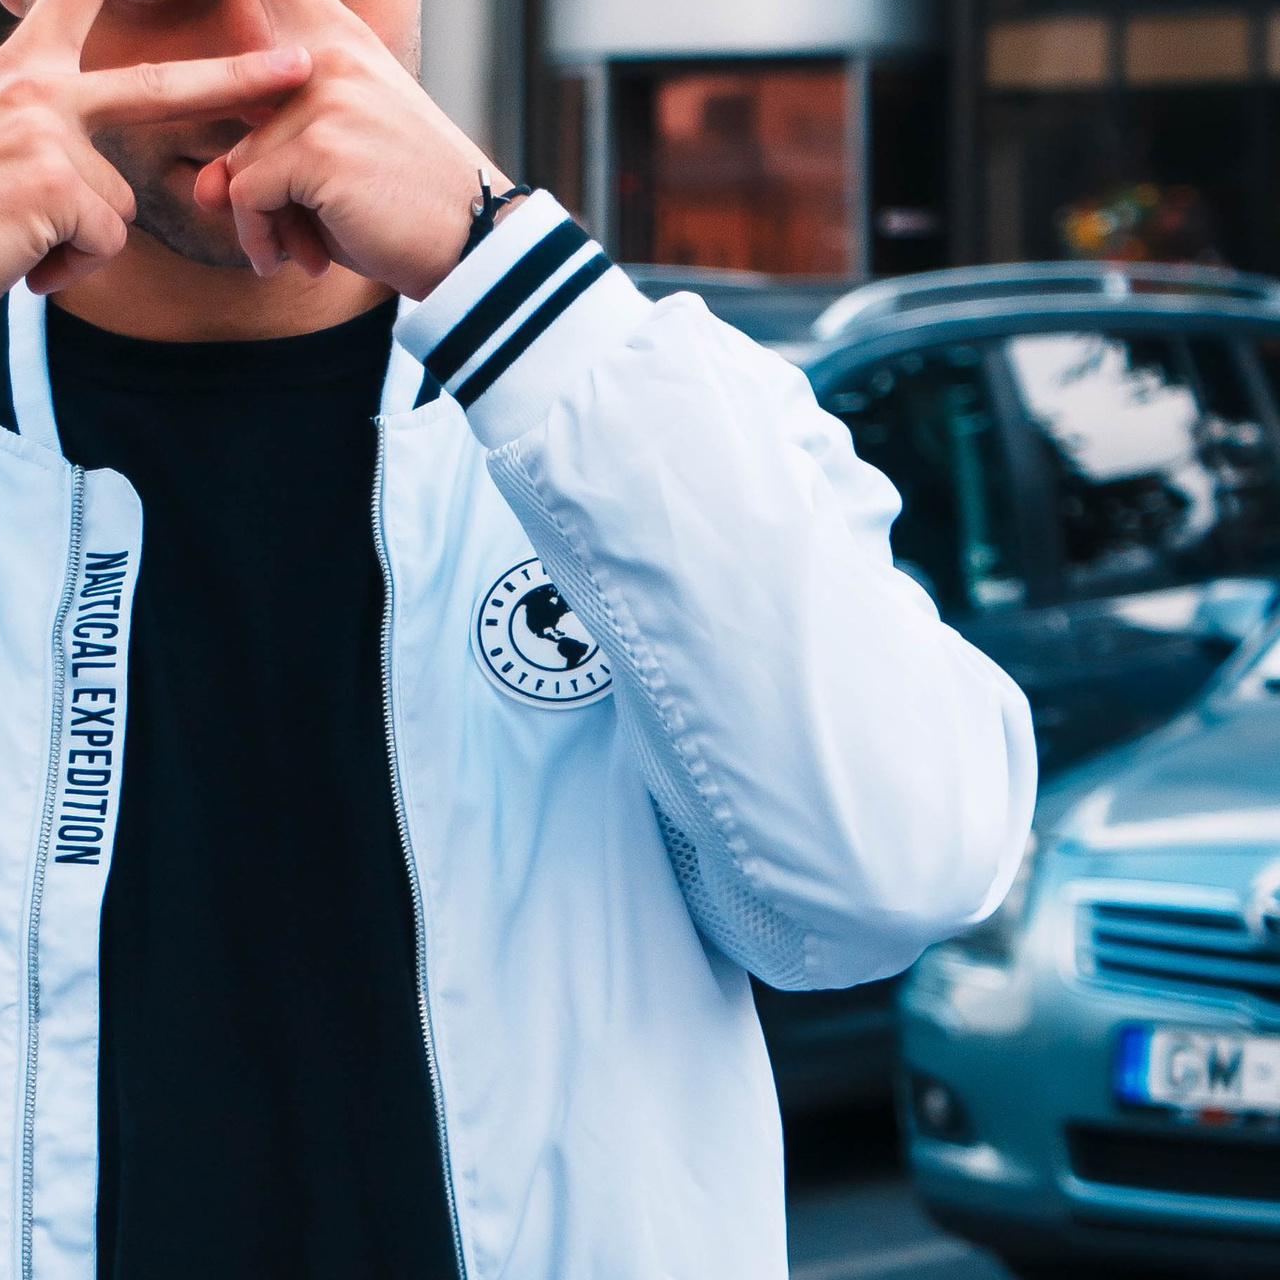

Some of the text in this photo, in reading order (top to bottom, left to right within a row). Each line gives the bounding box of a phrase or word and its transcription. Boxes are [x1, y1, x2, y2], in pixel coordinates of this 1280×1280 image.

[484, 567, 548, 627] NORT
[54, 550, 129, 866] NAUTICAL EXPEDITION
